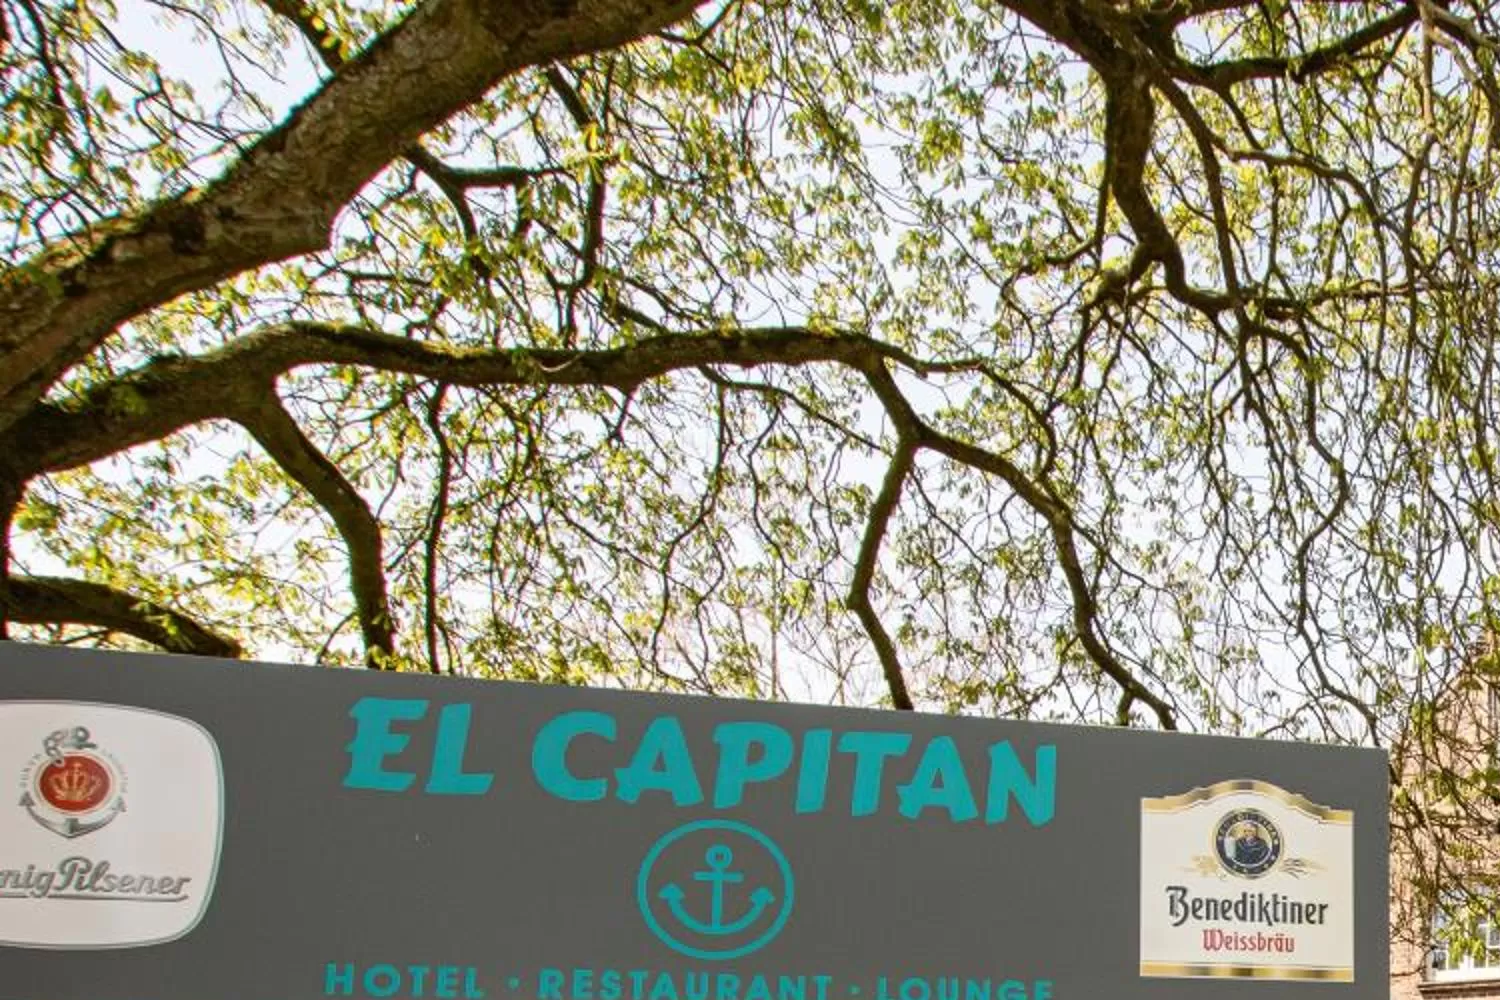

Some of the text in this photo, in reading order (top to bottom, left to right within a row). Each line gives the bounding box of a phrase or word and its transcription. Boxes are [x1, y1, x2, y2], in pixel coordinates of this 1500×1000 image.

[343, 697, 1057, 826] EL CAPITAN
[1166, 885, 1329, 927] Benediktiner
[1203, 928, 1295, 952] Weissbräu
[325, 963, 484, 999] HOTEL
